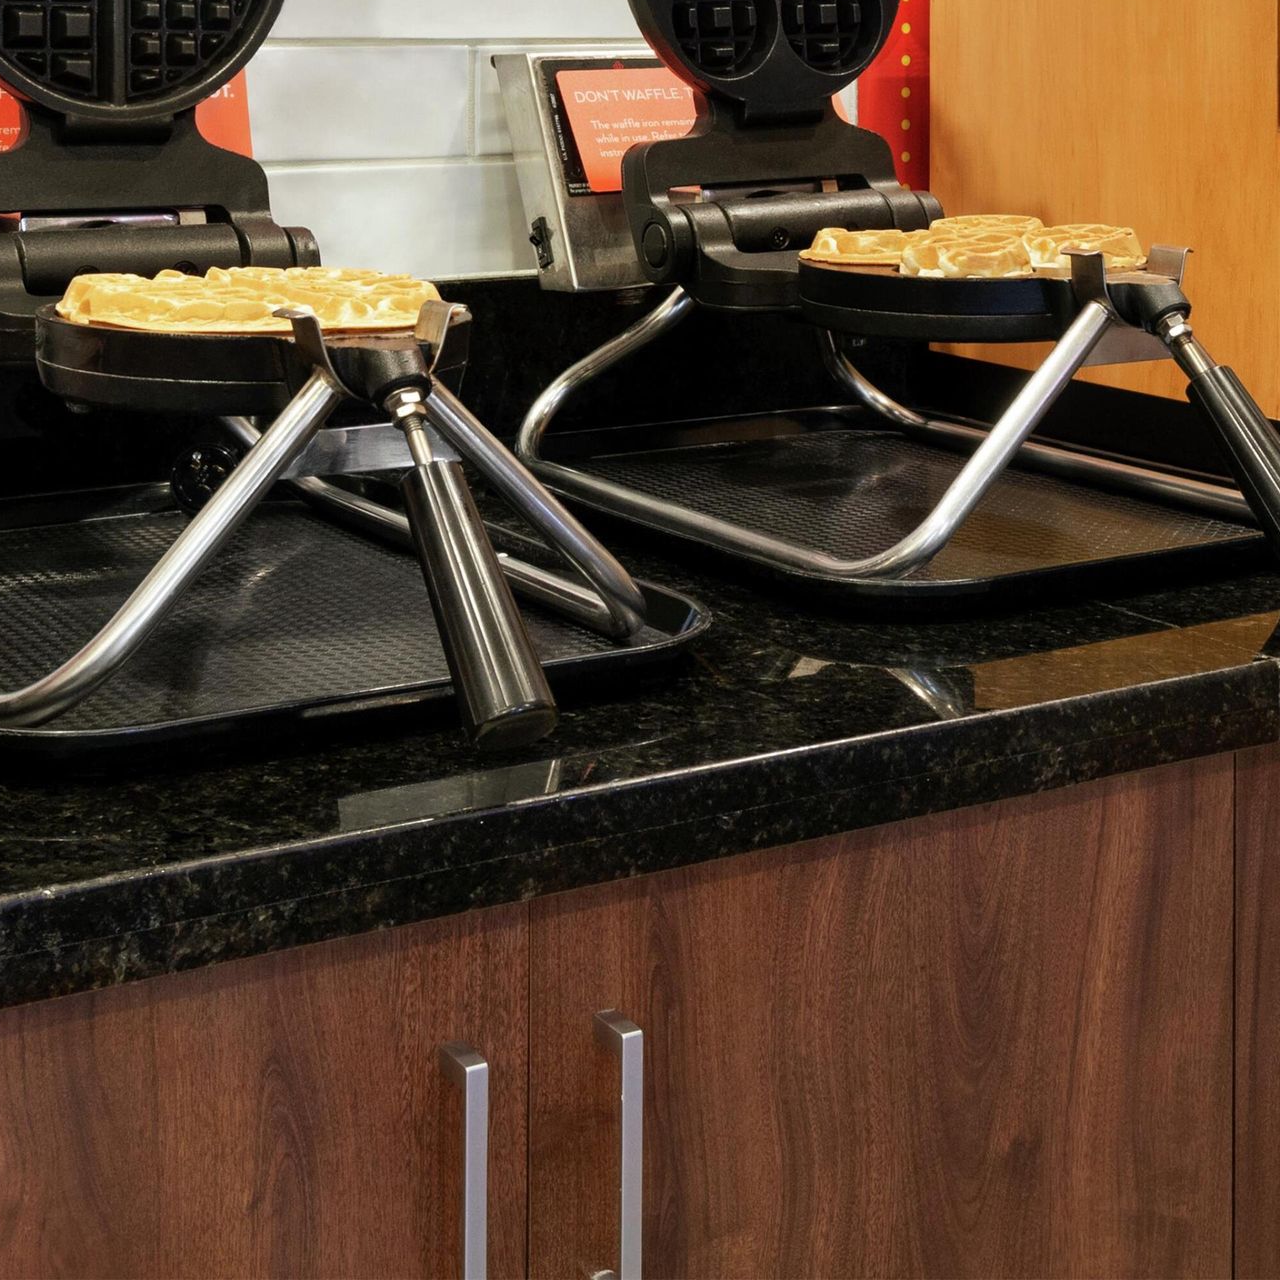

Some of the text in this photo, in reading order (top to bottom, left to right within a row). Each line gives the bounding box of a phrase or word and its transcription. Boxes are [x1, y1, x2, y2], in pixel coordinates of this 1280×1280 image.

[574, 89, 620, 103] DON'T
[590, 120, 611, 130] The
[611, 118, 641, 129] waffle
[595, 133, 620, 144] while
[622, 133, 631, 143] in
